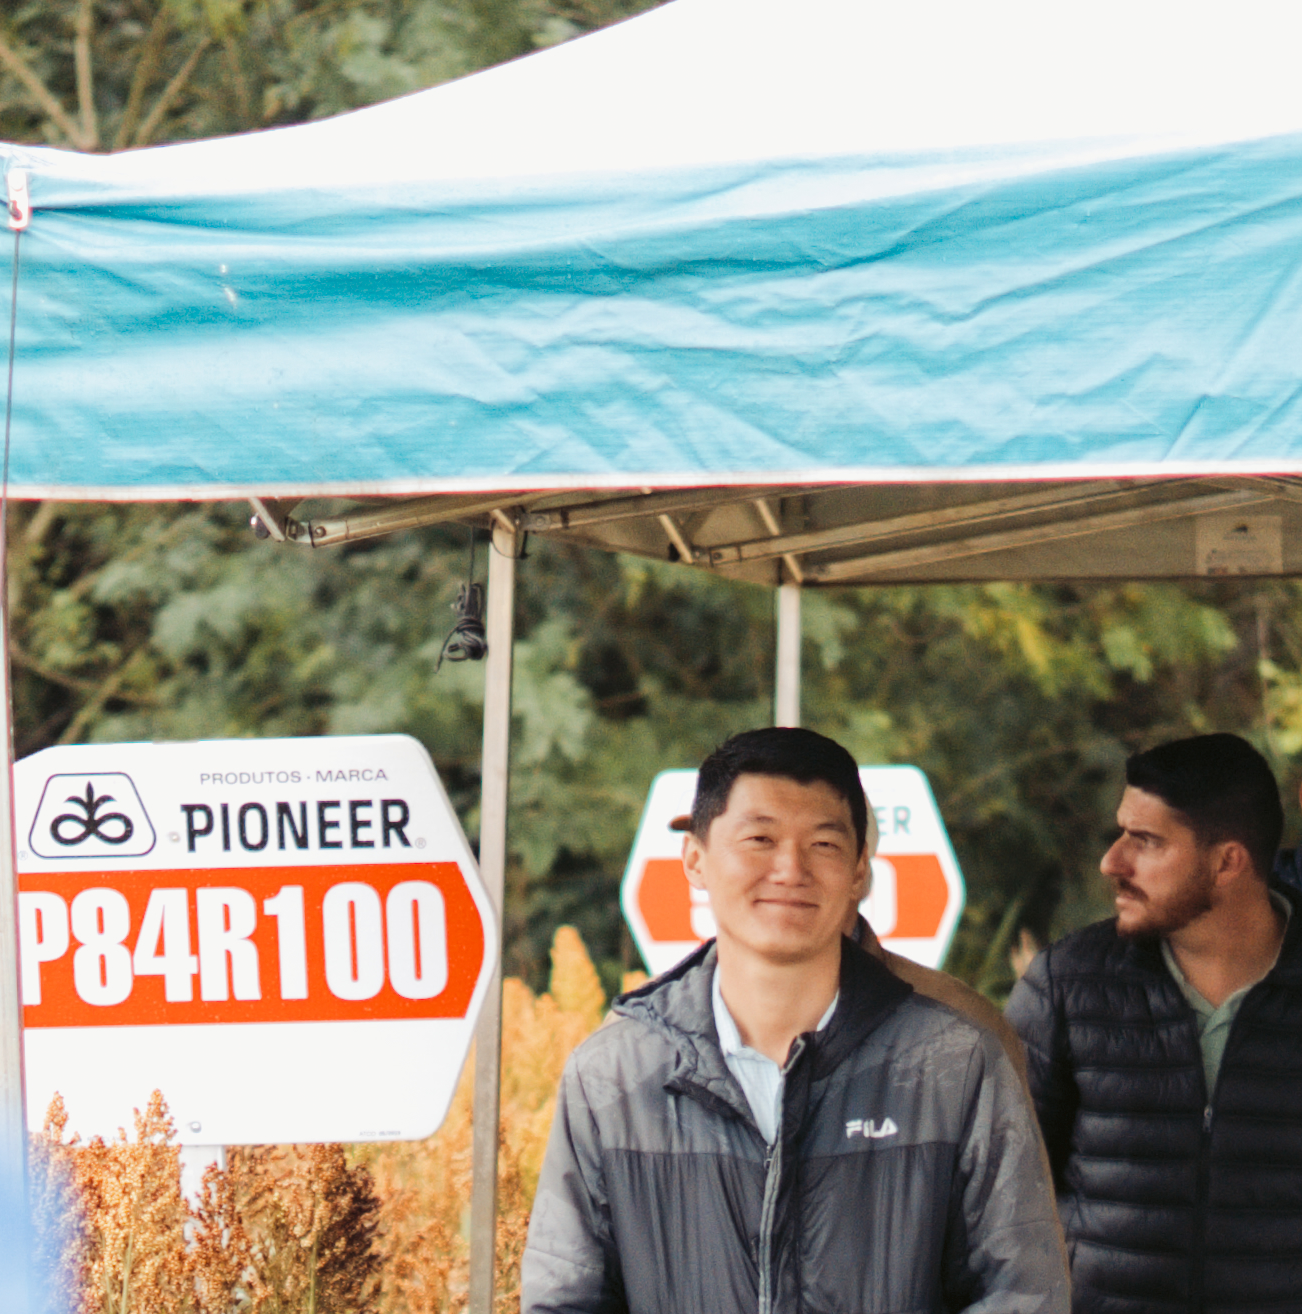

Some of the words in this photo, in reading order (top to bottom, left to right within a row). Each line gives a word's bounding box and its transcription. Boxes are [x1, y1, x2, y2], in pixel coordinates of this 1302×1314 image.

[199, 770, 302, 786] PRODUTOS
[315, 768, 389, 783] MARCA
[180, 798, 414, 853] PIONEER
[17, 880, 450, 1007] P84R100
[845, 1117, 898, 1139] FILA
